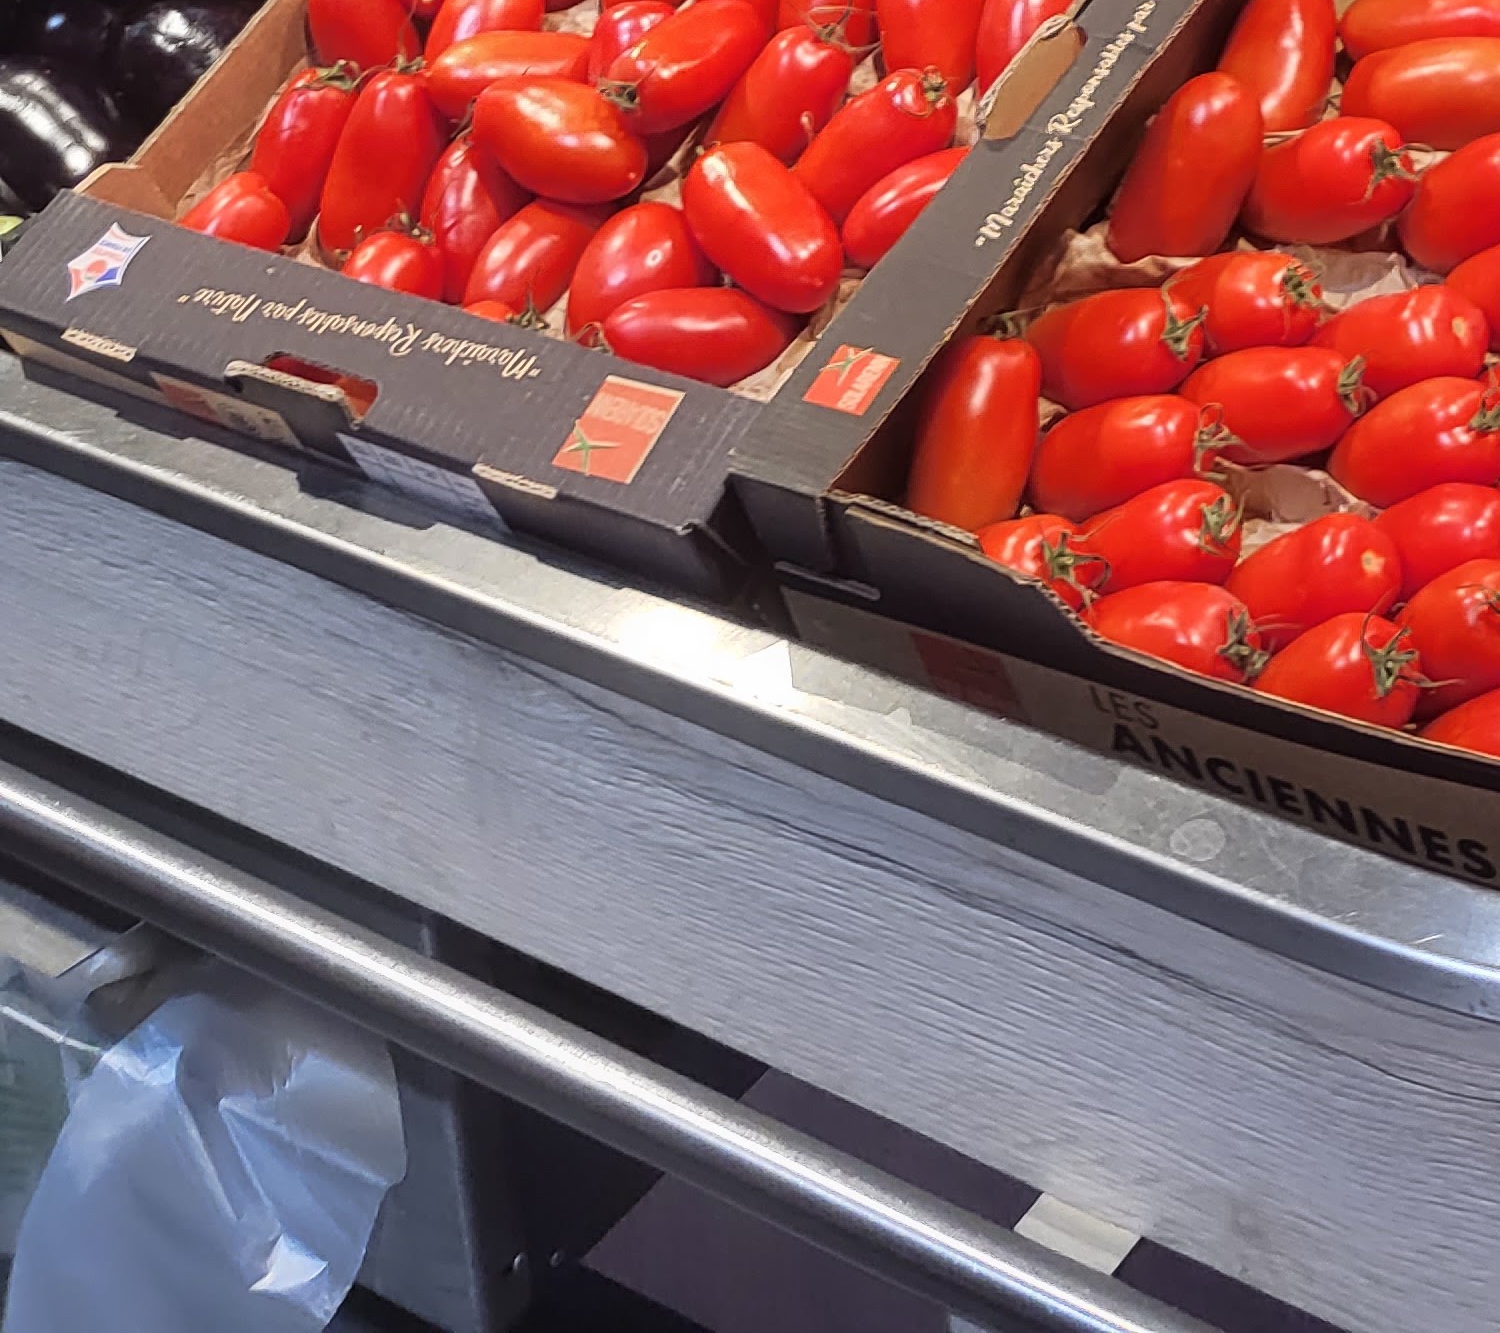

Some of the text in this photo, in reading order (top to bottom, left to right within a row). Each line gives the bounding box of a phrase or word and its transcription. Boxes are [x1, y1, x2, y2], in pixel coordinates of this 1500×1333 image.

[1046, 28, 1137, 137] Responsables
[1126, 0, 1158, 34] par
[261, 298, 307, 330] par
[299, 307, 423, 358] Responsables
[1088, 684, 1160, 731] LES
[1111, 723, 1498, 881] ANCIENNES
